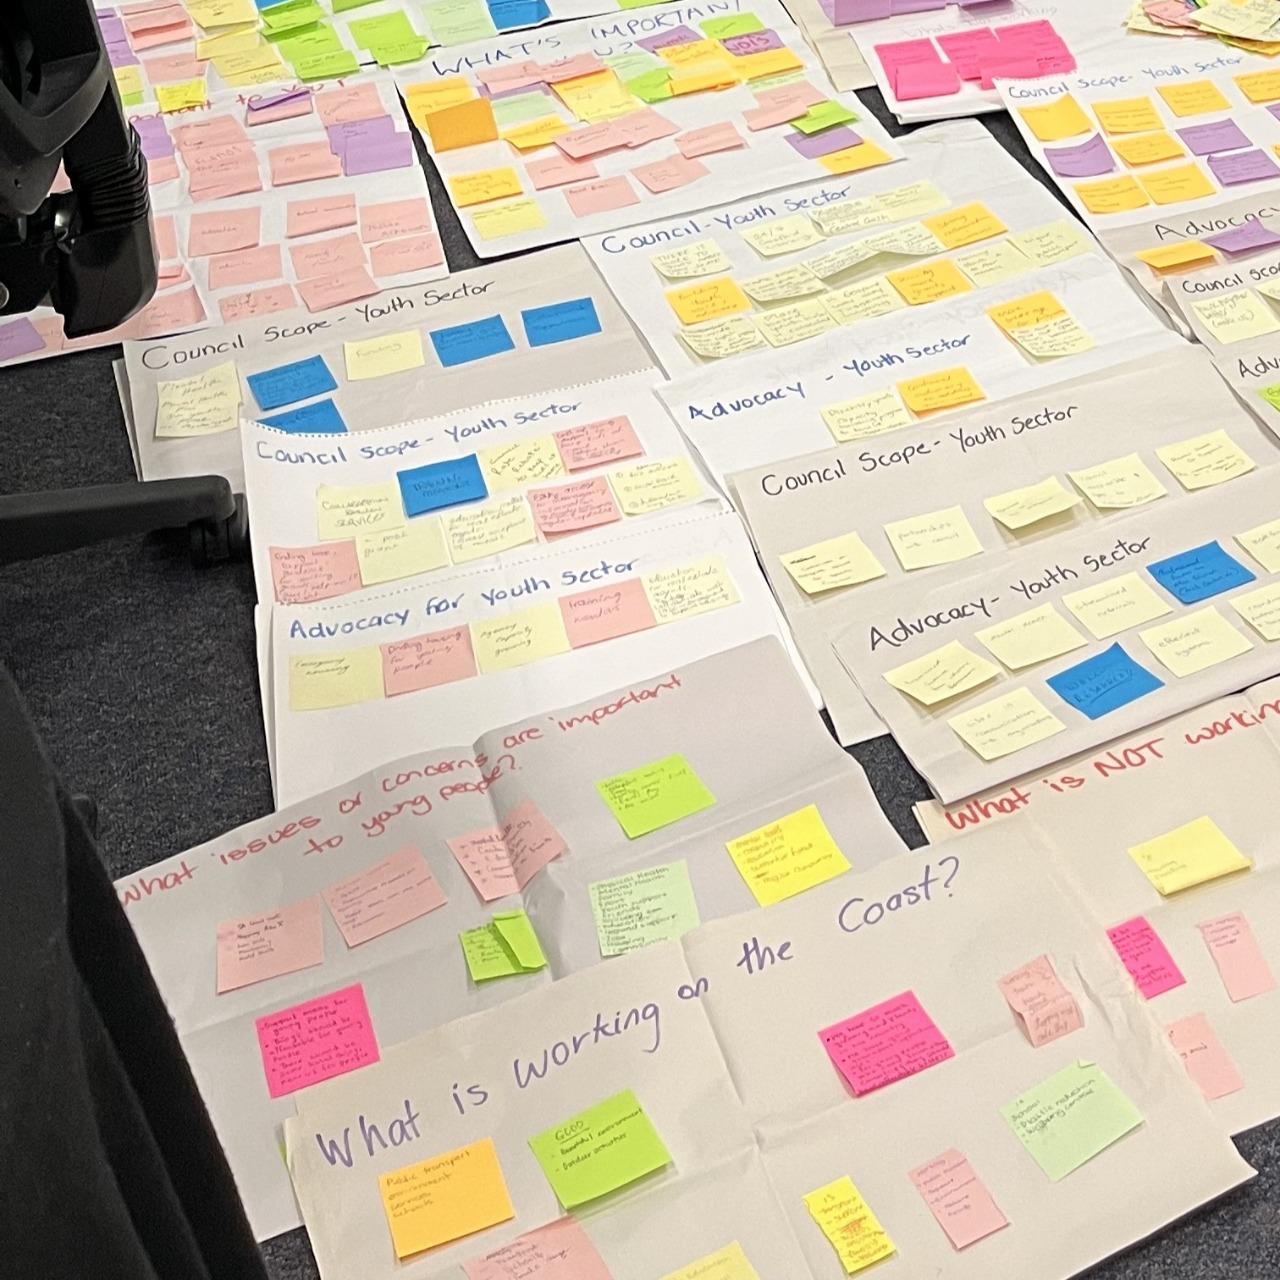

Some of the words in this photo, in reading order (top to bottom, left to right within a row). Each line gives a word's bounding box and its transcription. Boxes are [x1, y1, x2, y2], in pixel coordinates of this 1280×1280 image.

[431, 36, 562, 76] WHAT'S
[1008, 81, 1070, 100] Council
[1140, 64, 1190, 81] Youth
[1194, 54, 1244, 74] Sector
[601, 220, 702, 255] Council
[713, 204, 777, 231] Youth
[783, 186, 852, 212] Sector
[1181, 273, 1244, 296] Council
[141, 334, 245, 370] Council
[264, 320, 334, 342] Scope
[355, 295, 415, 323] Youth
[423, 279, 496, 307] Sector
[688, 382, 806, 422] Advocacy
[842, 353, 905, 378] Youth
[905, 334, 972, 360] Sector
[256, 440, 348, 465] Council
[444, 417, 508, 443] Youth
[513, 401, 583, 426] Sector
[761, 459, 847, 496] Council
[949, 424, 1007, 453] Youth
[1010, 405, 1079, 436] Sector
[289, 608, 411, 639] Advocacy
[425, 592, 466, 617] for
[560, 558, 643, 587] Sector
[1009, 565, 1079, 600] Youth
[1083, 537, 1152, 573] Sector
[210, 816, 322, 867] issues
[338, 791, 364, 814] or
[382, 751, 489, 793] concerns
[503, 727, 544, 750] are
[548, 674, 683, 732] important
[302, 834, 344, 857] to
[360, 794, 433, 839] young
[439, 754, 523, 802] people?
[945, 787, 1033, 832] What
[1044, 770, 1086, 795] is
[1093, 737, 1166, 781] NOT
[837, 856, 962, 935] Coast?
[676, 977, 710, 1001] on
[736, 936, 796, 977] the
[315, 1098, 421, 1169] What
[452, 1081, 489, 1116] is
